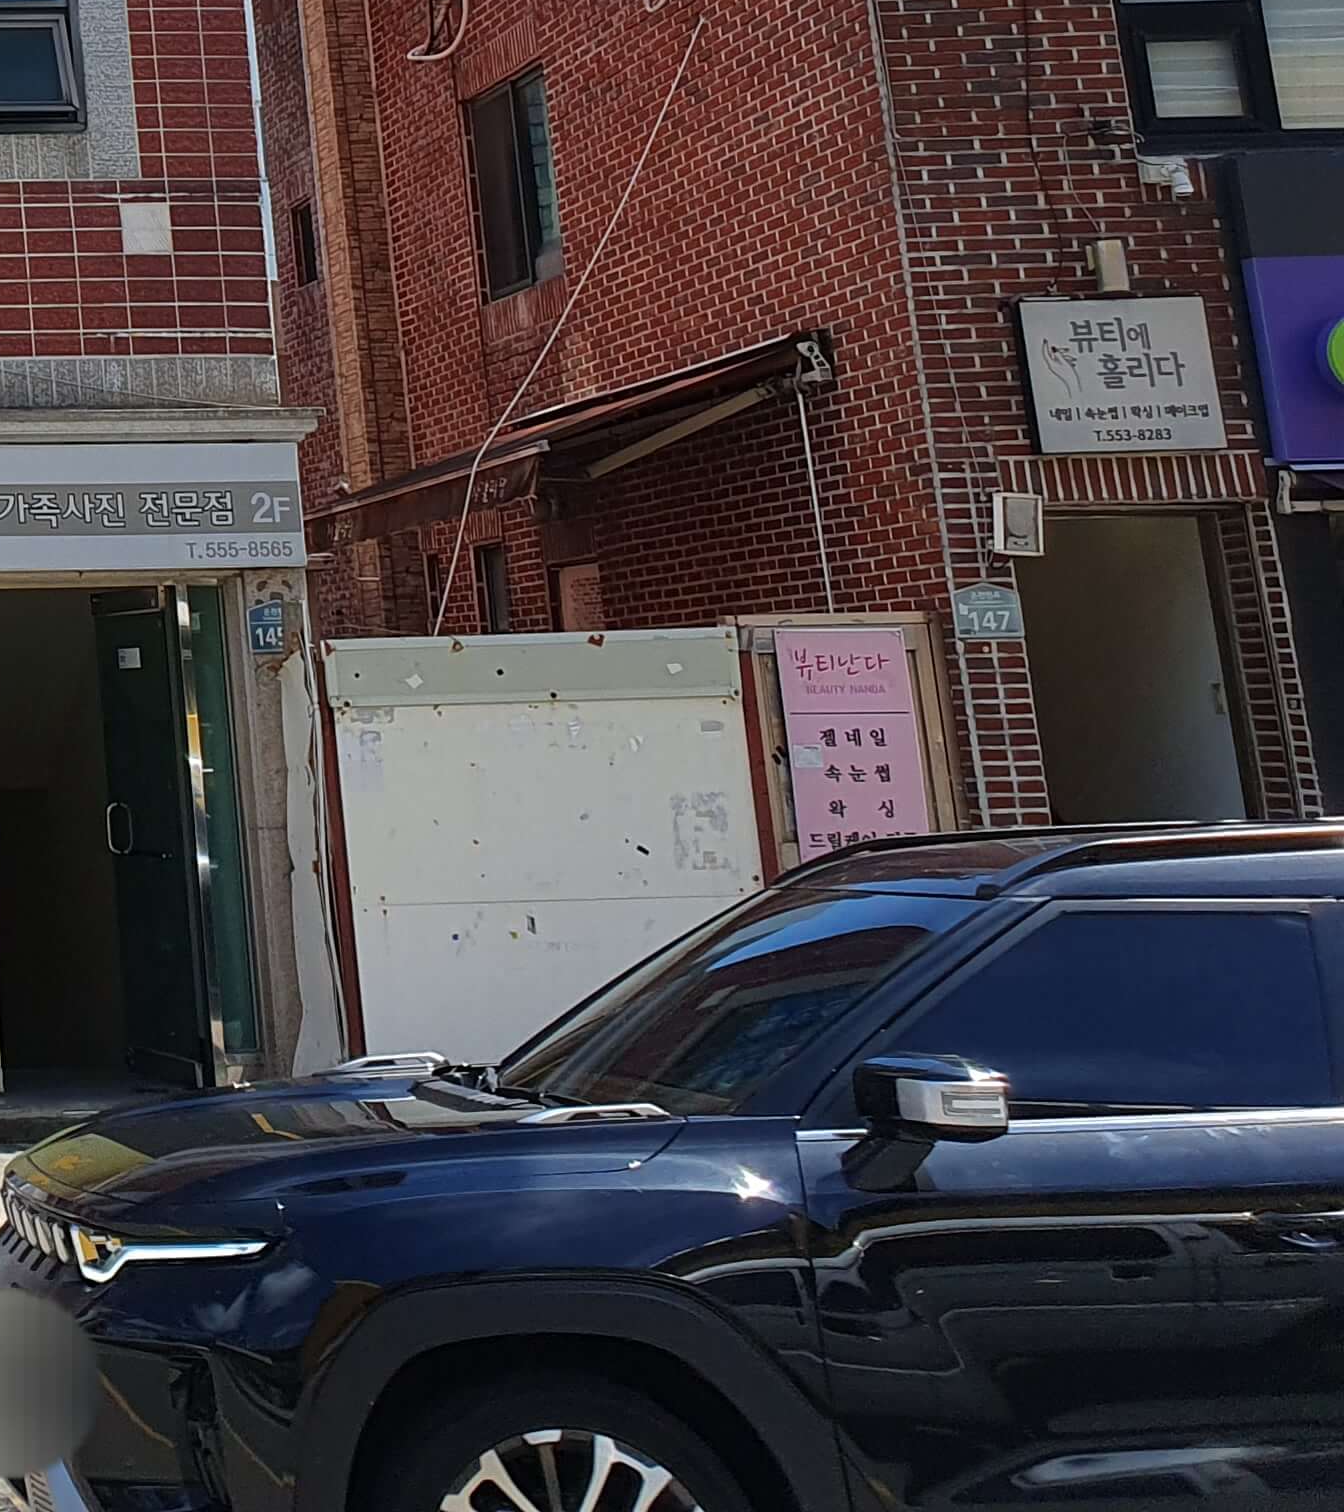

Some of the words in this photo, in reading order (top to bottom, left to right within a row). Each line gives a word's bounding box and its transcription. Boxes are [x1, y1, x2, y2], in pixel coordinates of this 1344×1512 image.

[1068, 317, 1152, 353] 뷰티에
[1097, 352, 1186, 389] 홀리다
[1093, 428, 1172, 442] T.553-8283
[139, 491, 235, 527] 전문점
[251, 492, 291, 523] 2F
[185, 541, 294, 560] T.555-8565
[968, 610, 1011, 632] 147
